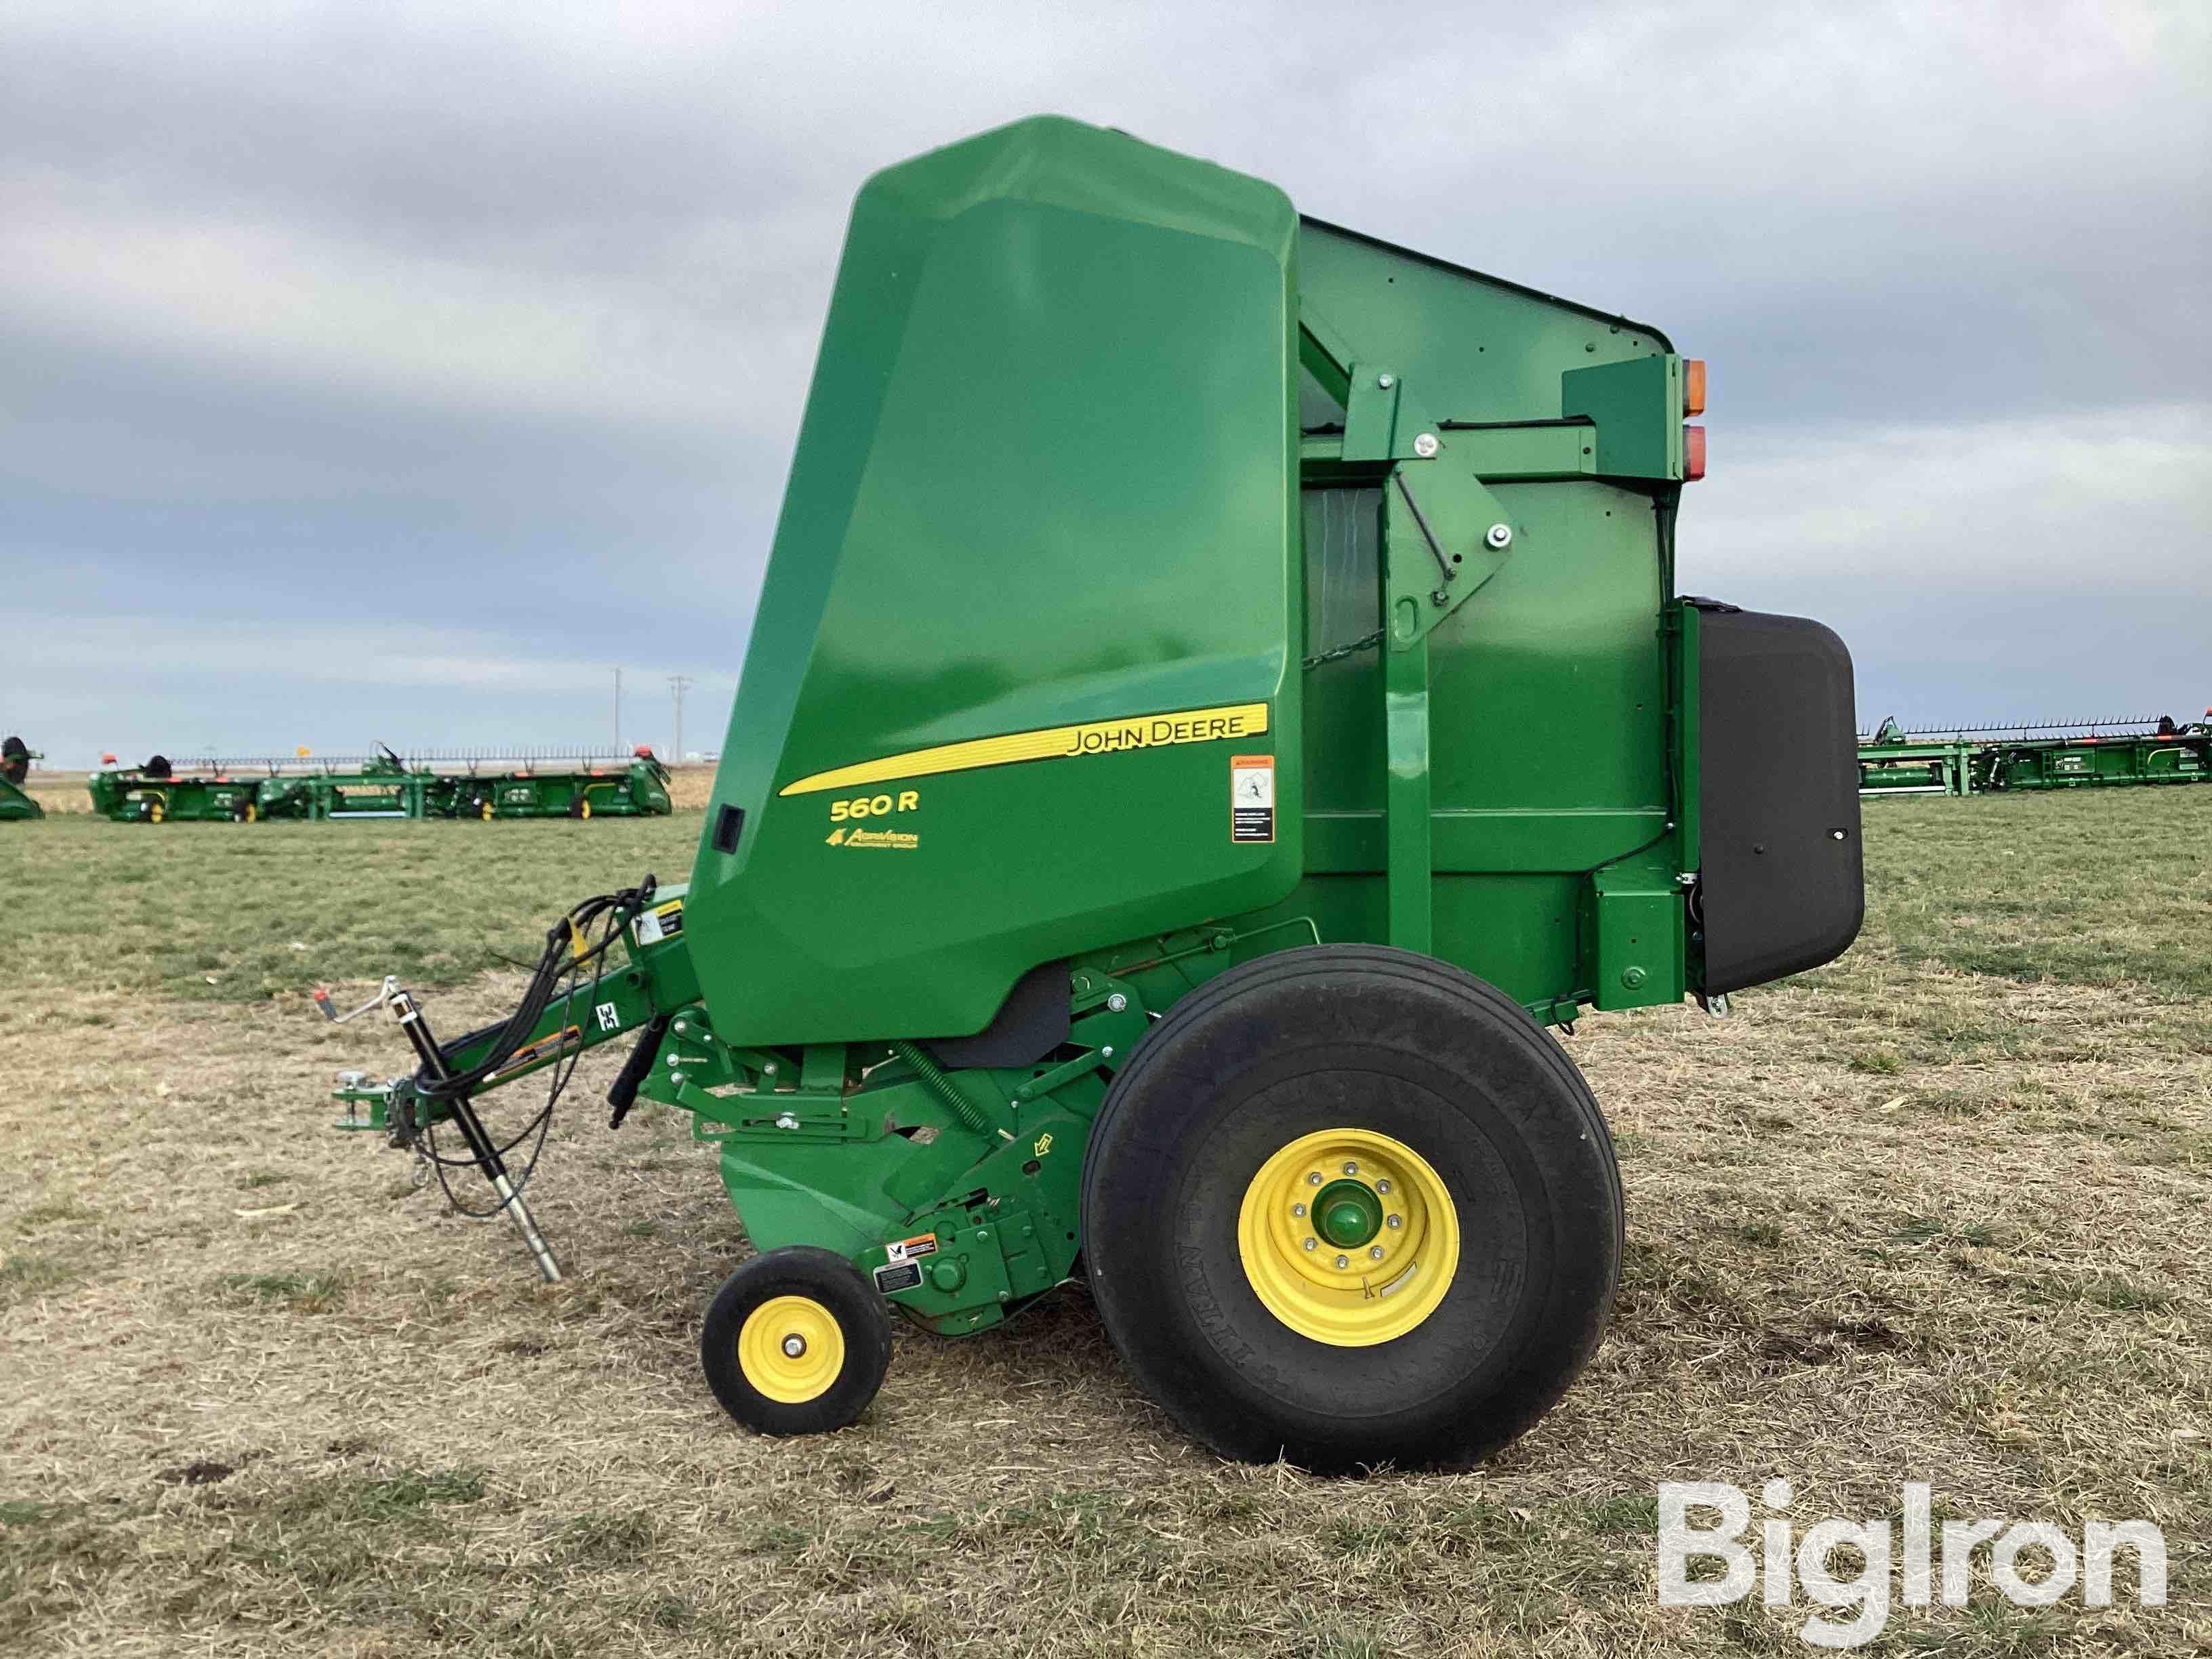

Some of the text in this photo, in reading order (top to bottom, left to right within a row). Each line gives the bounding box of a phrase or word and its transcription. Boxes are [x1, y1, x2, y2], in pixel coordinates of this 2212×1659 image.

[1067, 716, 1245, 752] JOHN DEERE
[830, 791, 919, 821] 560 R
